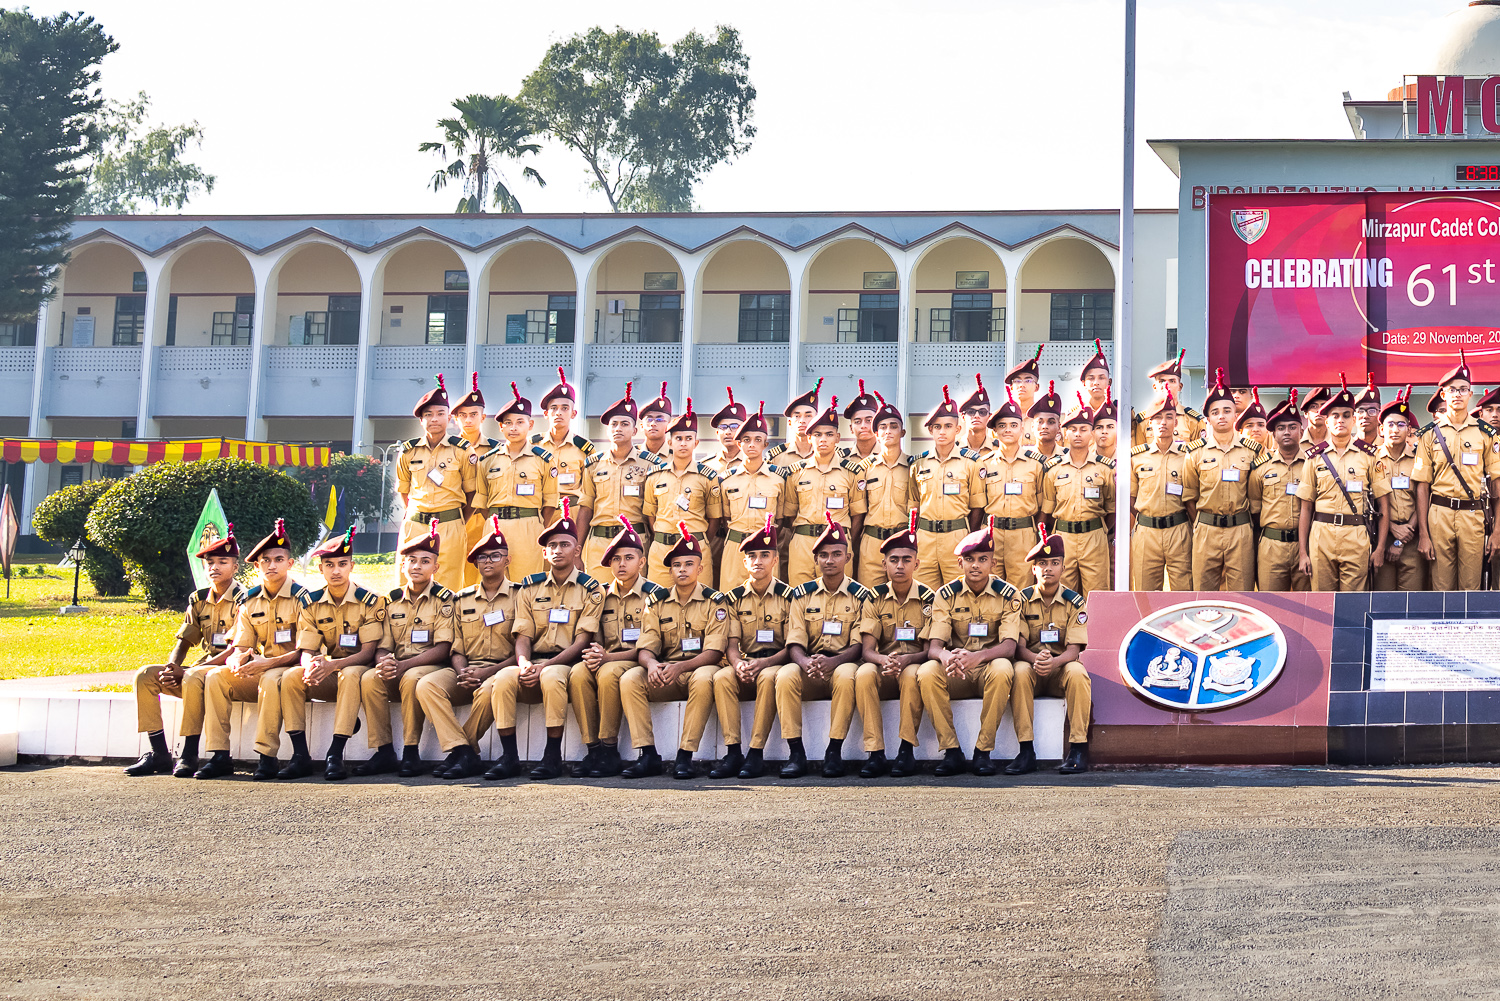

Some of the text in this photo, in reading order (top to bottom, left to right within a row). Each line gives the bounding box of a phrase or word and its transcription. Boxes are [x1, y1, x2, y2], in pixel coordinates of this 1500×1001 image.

[1466, 166, 1498, 180] 8:38
[1361, 218, 1426, 242] Mirzapur
[1430, 217, 1474, 237] Cadet
[1245, 257, 1393, 289] CELEBRATING
[1406, 258, 1496, 307] 61st
[1382, 332, 1410, 345] Date:
[1413, 331, 1426, 344] 29
[1429, 331, 1486, 345] November,
